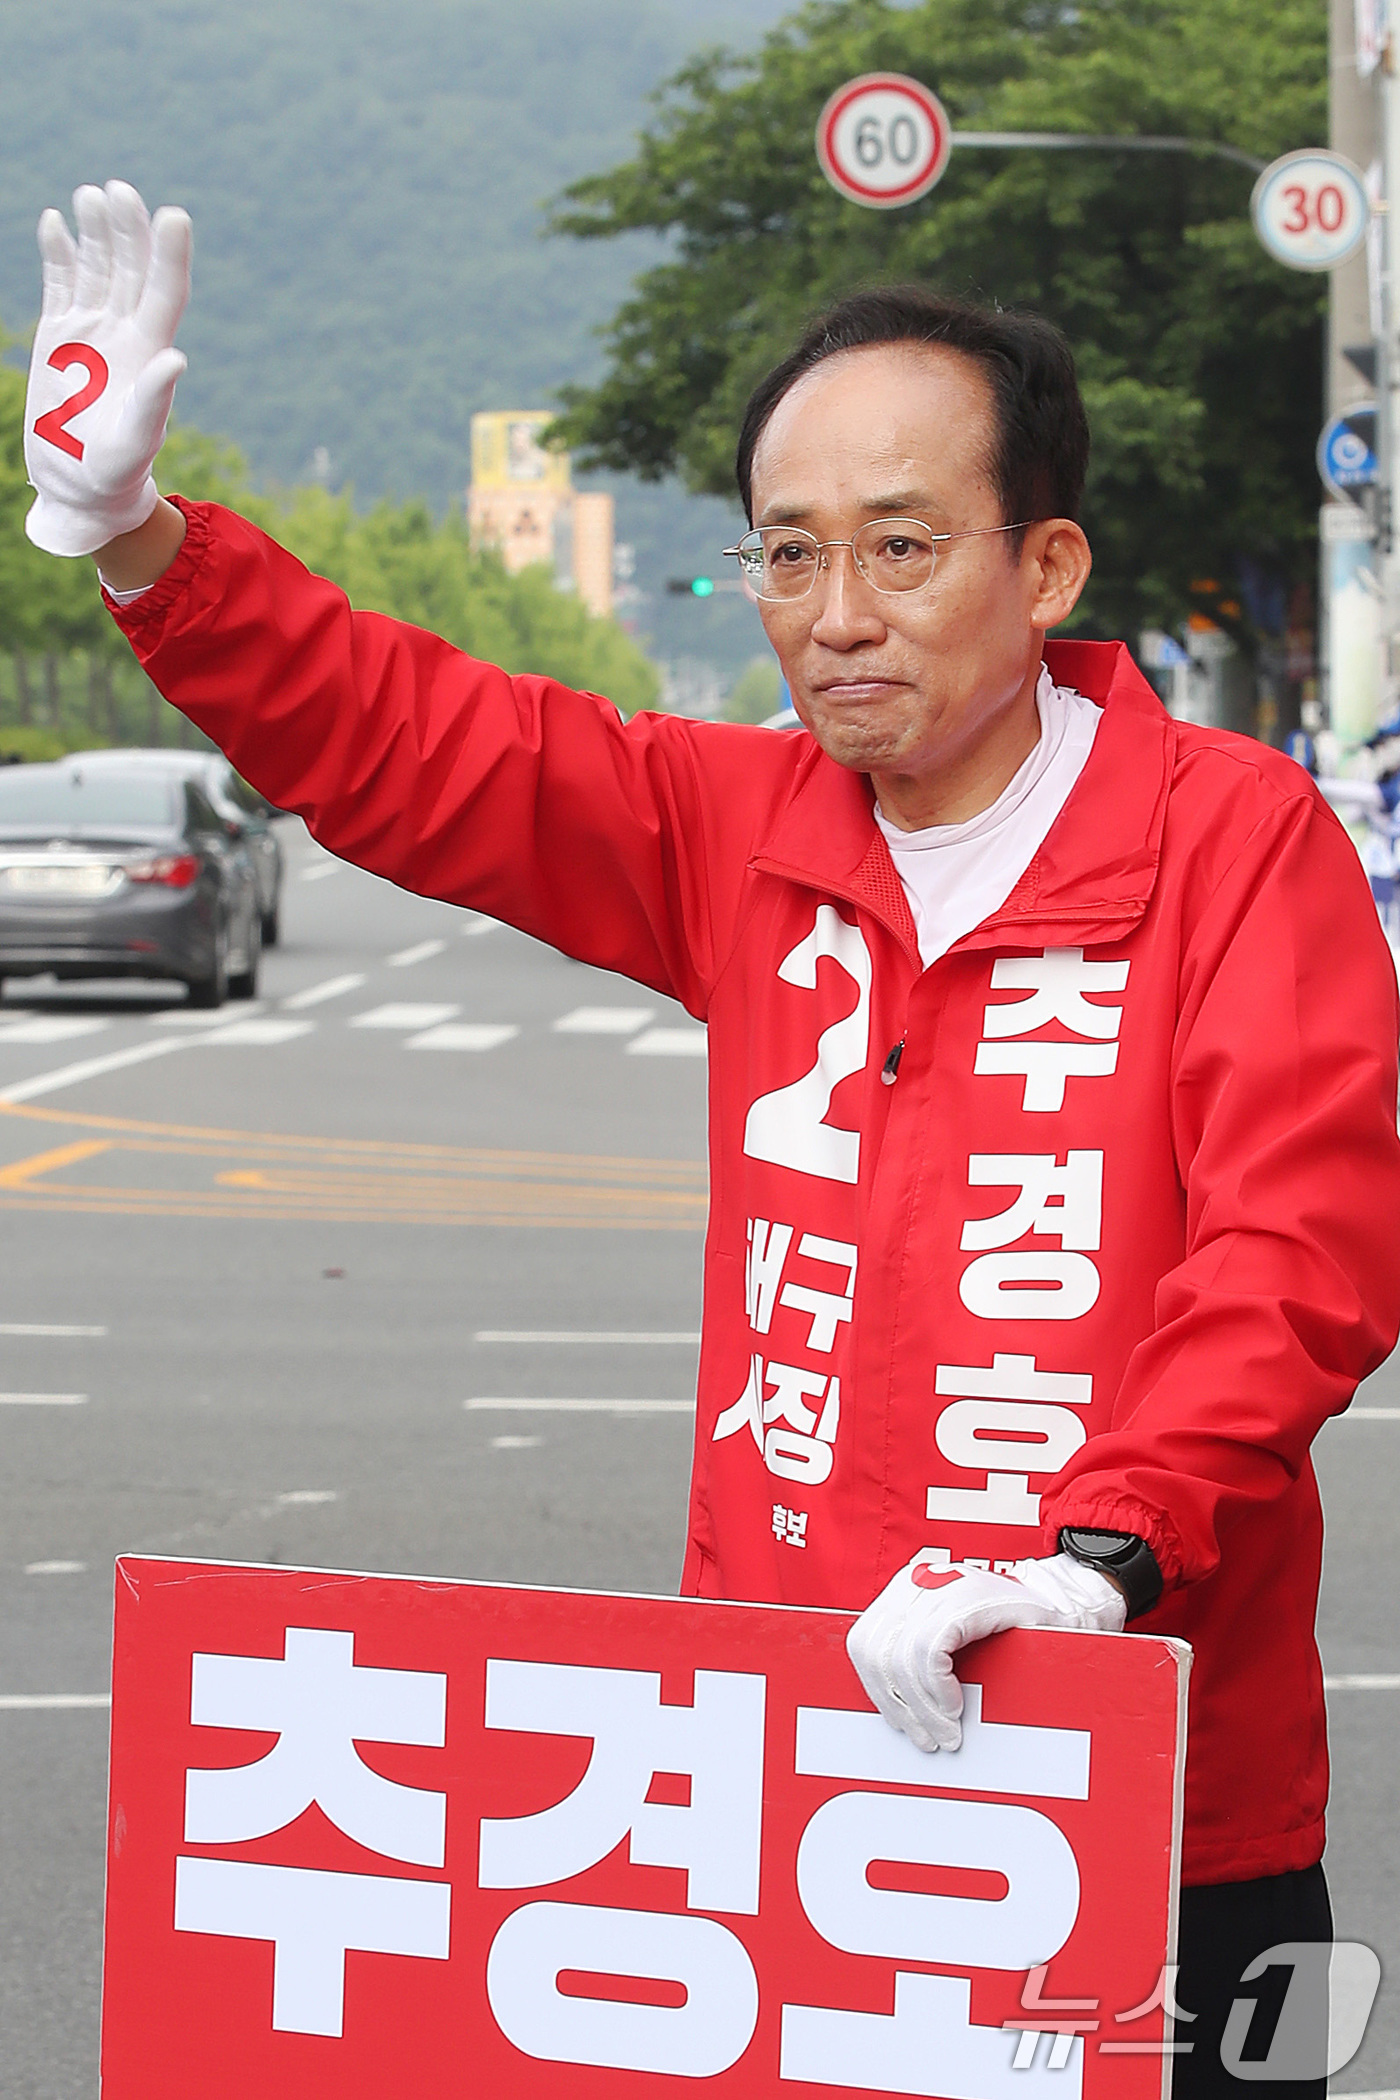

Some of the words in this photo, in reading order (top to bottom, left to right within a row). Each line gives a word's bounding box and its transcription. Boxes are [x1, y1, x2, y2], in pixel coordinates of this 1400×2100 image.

[854, 115, 919, 169] 60
[1281, 185, 1346, 233] 30
[33, 342, 109, 462] 2
[743, 904, 872, 1184] 2
[926, 947, 1131, 1527] 추경호
[771, 1503, 808, 1548] 후보
[174, 1627, 1091, 2100] 추경호
